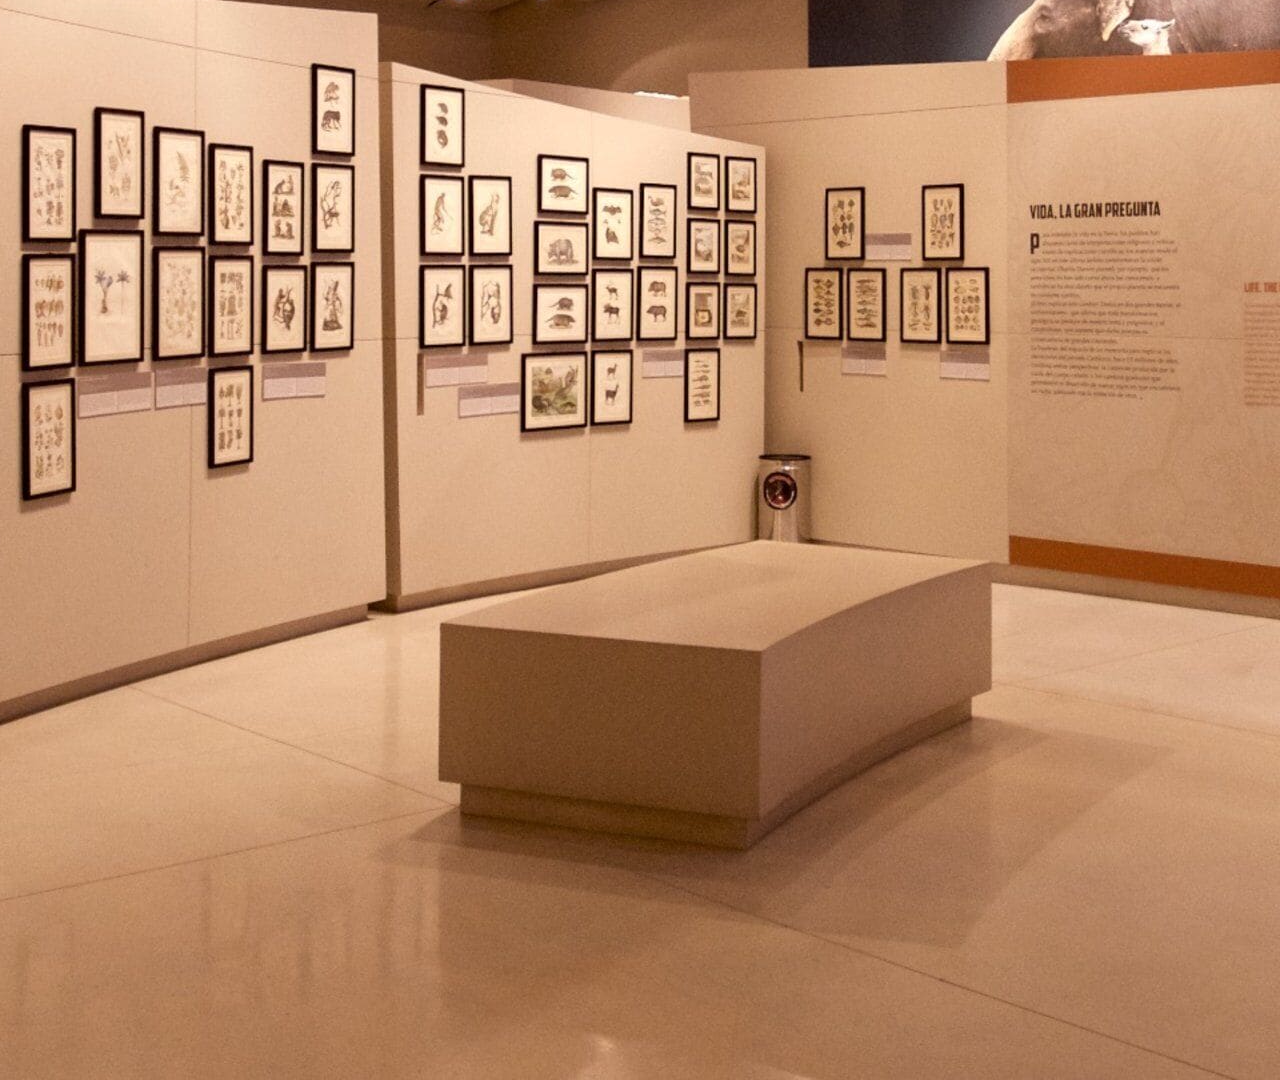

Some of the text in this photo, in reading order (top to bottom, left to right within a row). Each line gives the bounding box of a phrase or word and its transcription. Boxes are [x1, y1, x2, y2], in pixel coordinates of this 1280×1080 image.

[1059, 203, 1072, 219] LA
[1074, 202, 1103, 218] GRAN
[1104, 200, 1161, 218] PREGUNTA
